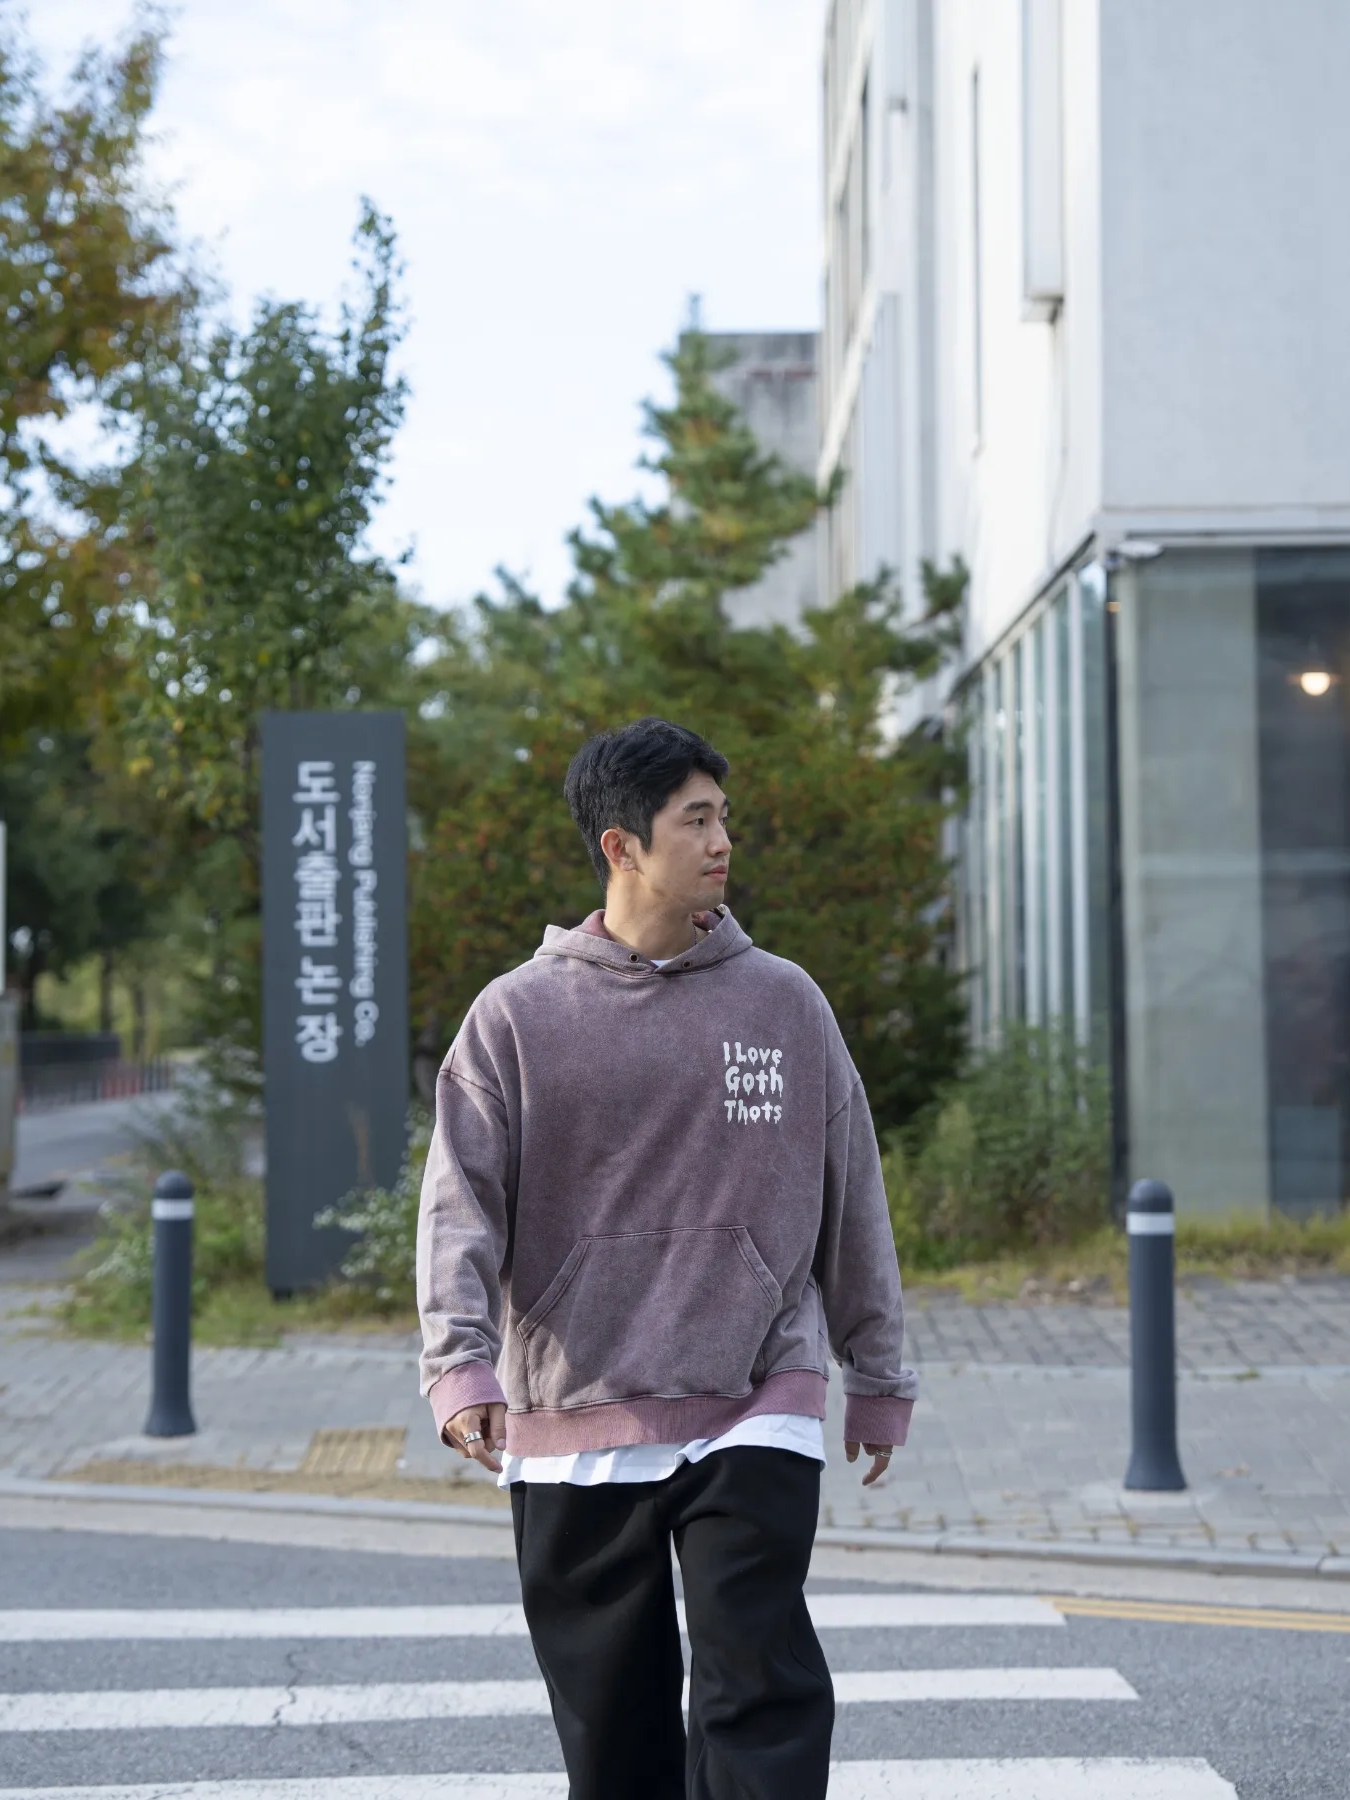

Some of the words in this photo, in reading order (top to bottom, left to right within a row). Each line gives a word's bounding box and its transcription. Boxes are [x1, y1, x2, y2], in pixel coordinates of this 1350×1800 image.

[349, 761, 377, 867] Nonjang
[292, 761, 343, 947] 도서출판
[350, 869, 379, 998] Publishing
[354, 1000, 380, 1047] Co.
[723, 1041, 731, 1066] I
[734, 1041, 783, 1068] Love
[725, 1065, 784, 1098] Goth
[723, 1098, 783, 1125] Thots
